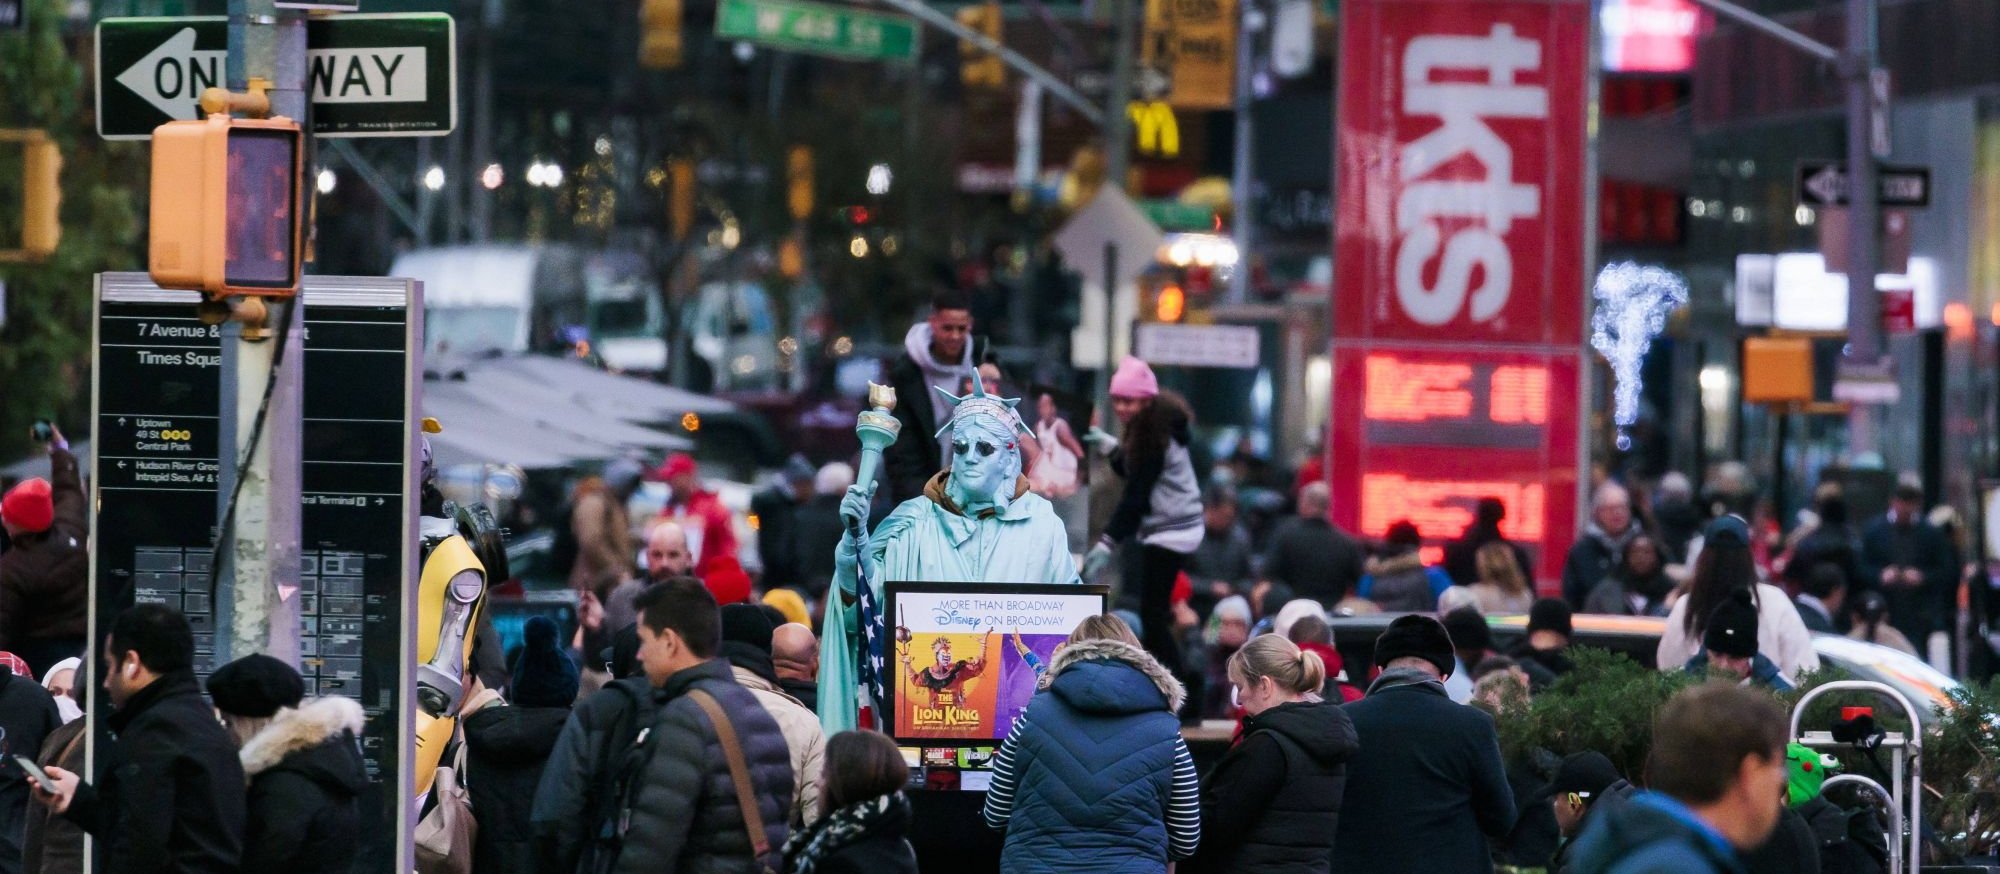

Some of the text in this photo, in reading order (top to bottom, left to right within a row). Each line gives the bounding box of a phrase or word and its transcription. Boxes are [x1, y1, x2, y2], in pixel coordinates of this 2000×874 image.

[155, 54, 404, 99] ON WAY
[1396, 22, 1549, 326] tkts
[137, 323, 220, 338] 7 Avenue &
[137, 351, 222, 368] Times Squa
[136, 418, 171, 428] Uptown
[136, 430, 148, 439] 49
[149, 430, 160, 439] St
[136, 441, 192, 451] Central Park
[136, 461, 219, 471] Hudson River Gree
[136, 472, 169, 482] Intrepid
[171, 473, 191, 482] Sea,
[192, 473, 204, 482] Air
[206, 474, 213, 482] &
[302, 496, 355, 505] tral Terminal
[940, 600, 1065, 611] MORE THAN BROADWAY
[931, 607, 1065, 631] Disney ON BROADWAY
[938, 693, 953, 702] THE
[913, 704, 979, 725] LION KING
